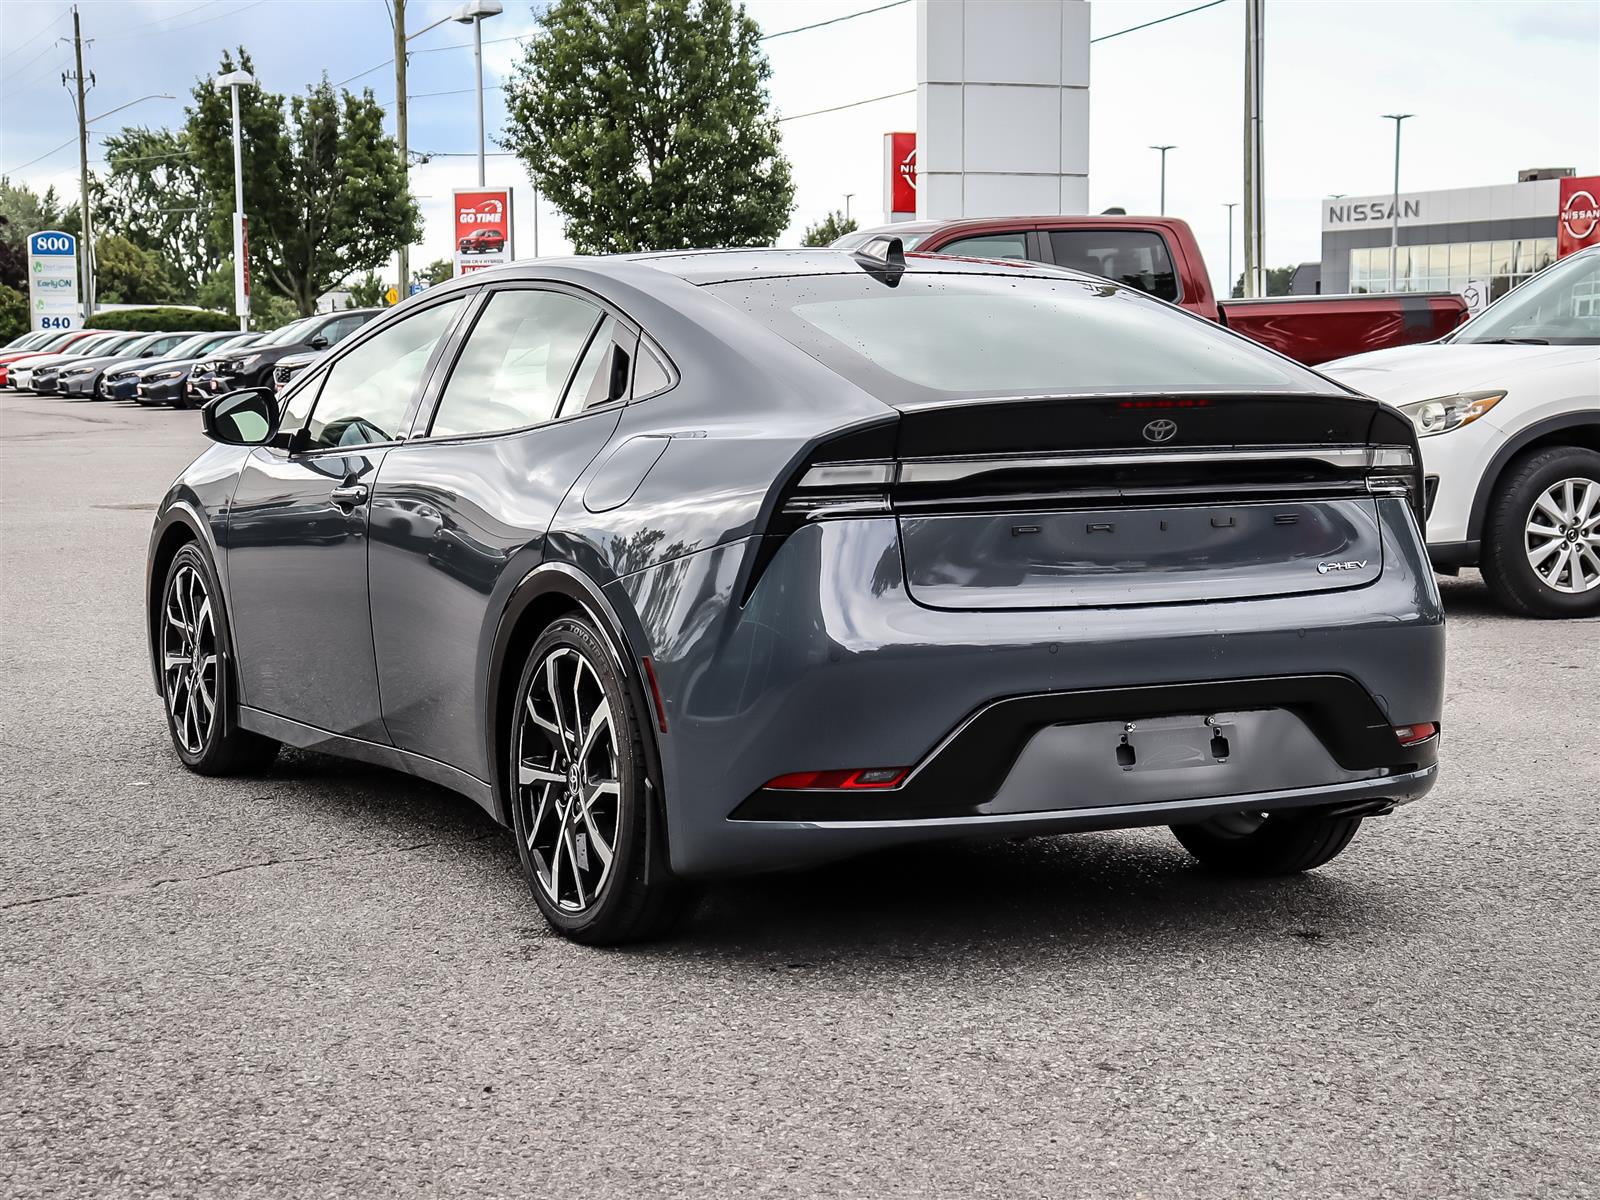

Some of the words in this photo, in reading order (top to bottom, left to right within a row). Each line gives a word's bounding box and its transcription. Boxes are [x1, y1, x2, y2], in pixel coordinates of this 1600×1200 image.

[460, 213, 475, 223] GO
[476, 213, 501, 223] TIME
[1329, 200, 1420, 223] NISSAN
[1561, 209, 1600, 221] NISSAN
[37, 237, 69, 251] 800
[37, 280, 72, 288] EarlyON
[41, 317, 70, 329] 840
[1011, 512, 1300, 537] PRIUS
[1327, 559, 1368, 572] PHEV
[570, 624, 589, 642] TOYO
